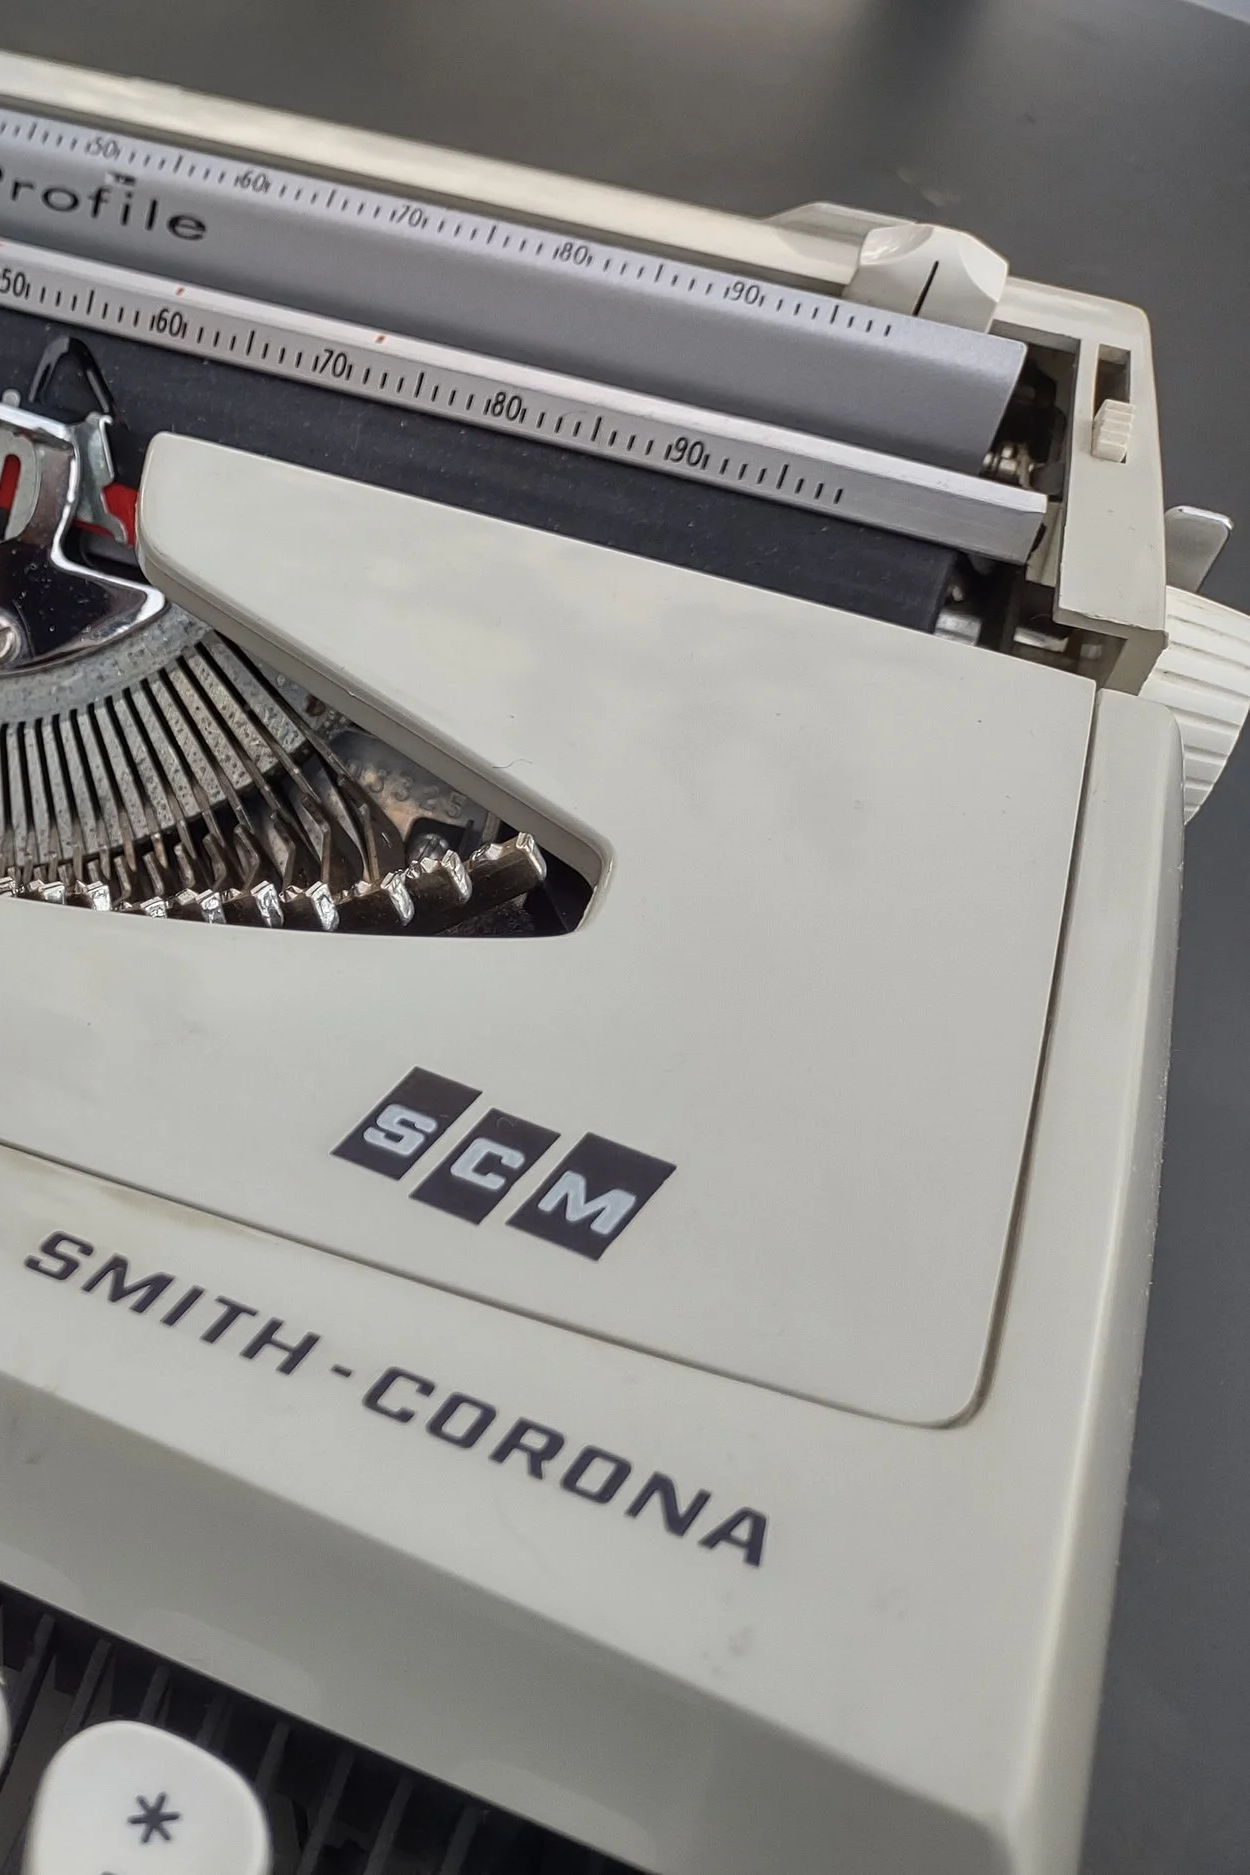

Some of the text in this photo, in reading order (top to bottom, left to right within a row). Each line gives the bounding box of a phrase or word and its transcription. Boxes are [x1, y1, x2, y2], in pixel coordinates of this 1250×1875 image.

[92, 137, 116, 158] 50
[239, 170, 267, 193] 60
[395, 204, 423, 229] 70
[559, 242, 588, 266] 80
[729, 281, 760, 305] 90
[0, 269, 27, 297] 50
[156, 308, 184, 338] 60
[319, 348, 350, 380] 70
[489, 391, 522, 422] 80
[670, 435, 703, 467] 90
[362, 1102, 637, 1237] SCM
